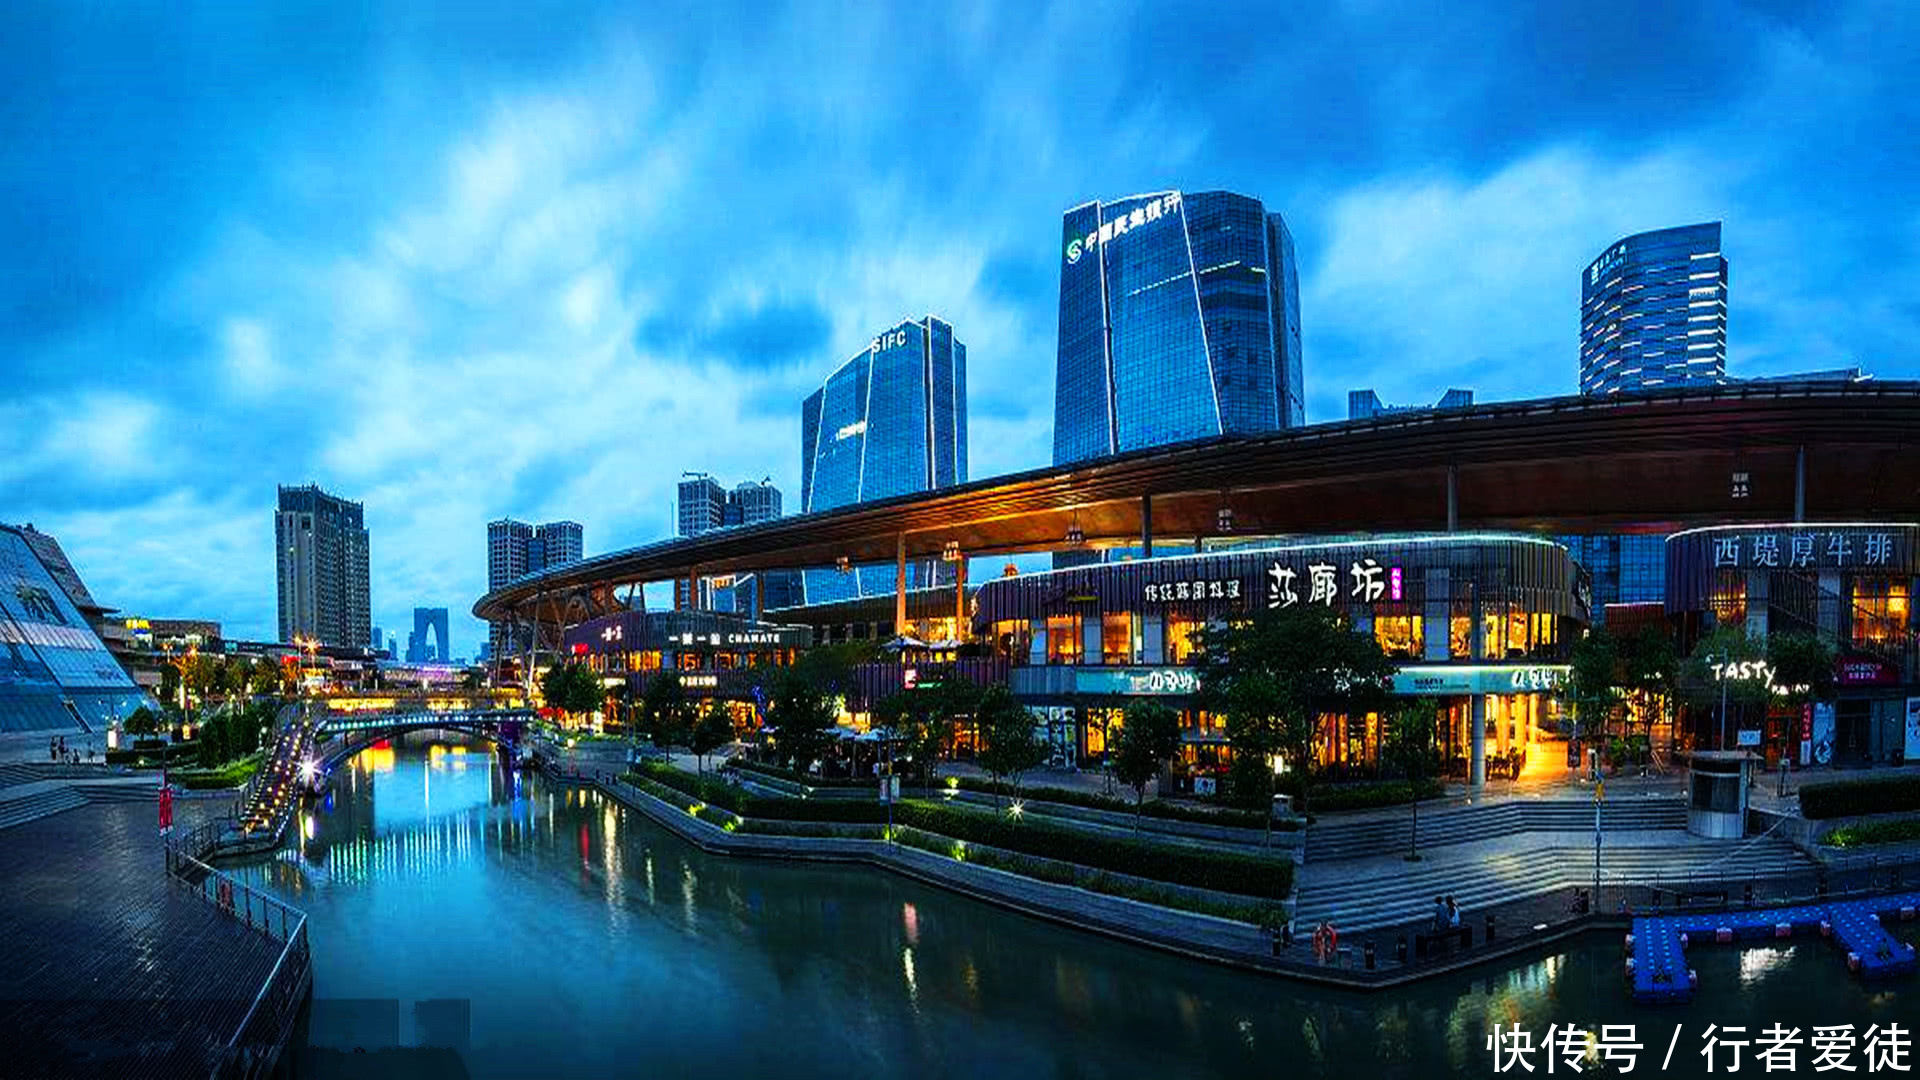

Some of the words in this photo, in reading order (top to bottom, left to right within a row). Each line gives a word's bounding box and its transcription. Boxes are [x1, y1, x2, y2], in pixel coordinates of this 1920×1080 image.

[872, 329, 907, 353] SIFC
[1713, 532, 1894, 568] 西堤厚牛排
[1268, 558, 1386, 608] 莎廊坊
[728, 633, 780, 644] CHAMATE
[1710, 659, 1777, 689] TASTY
